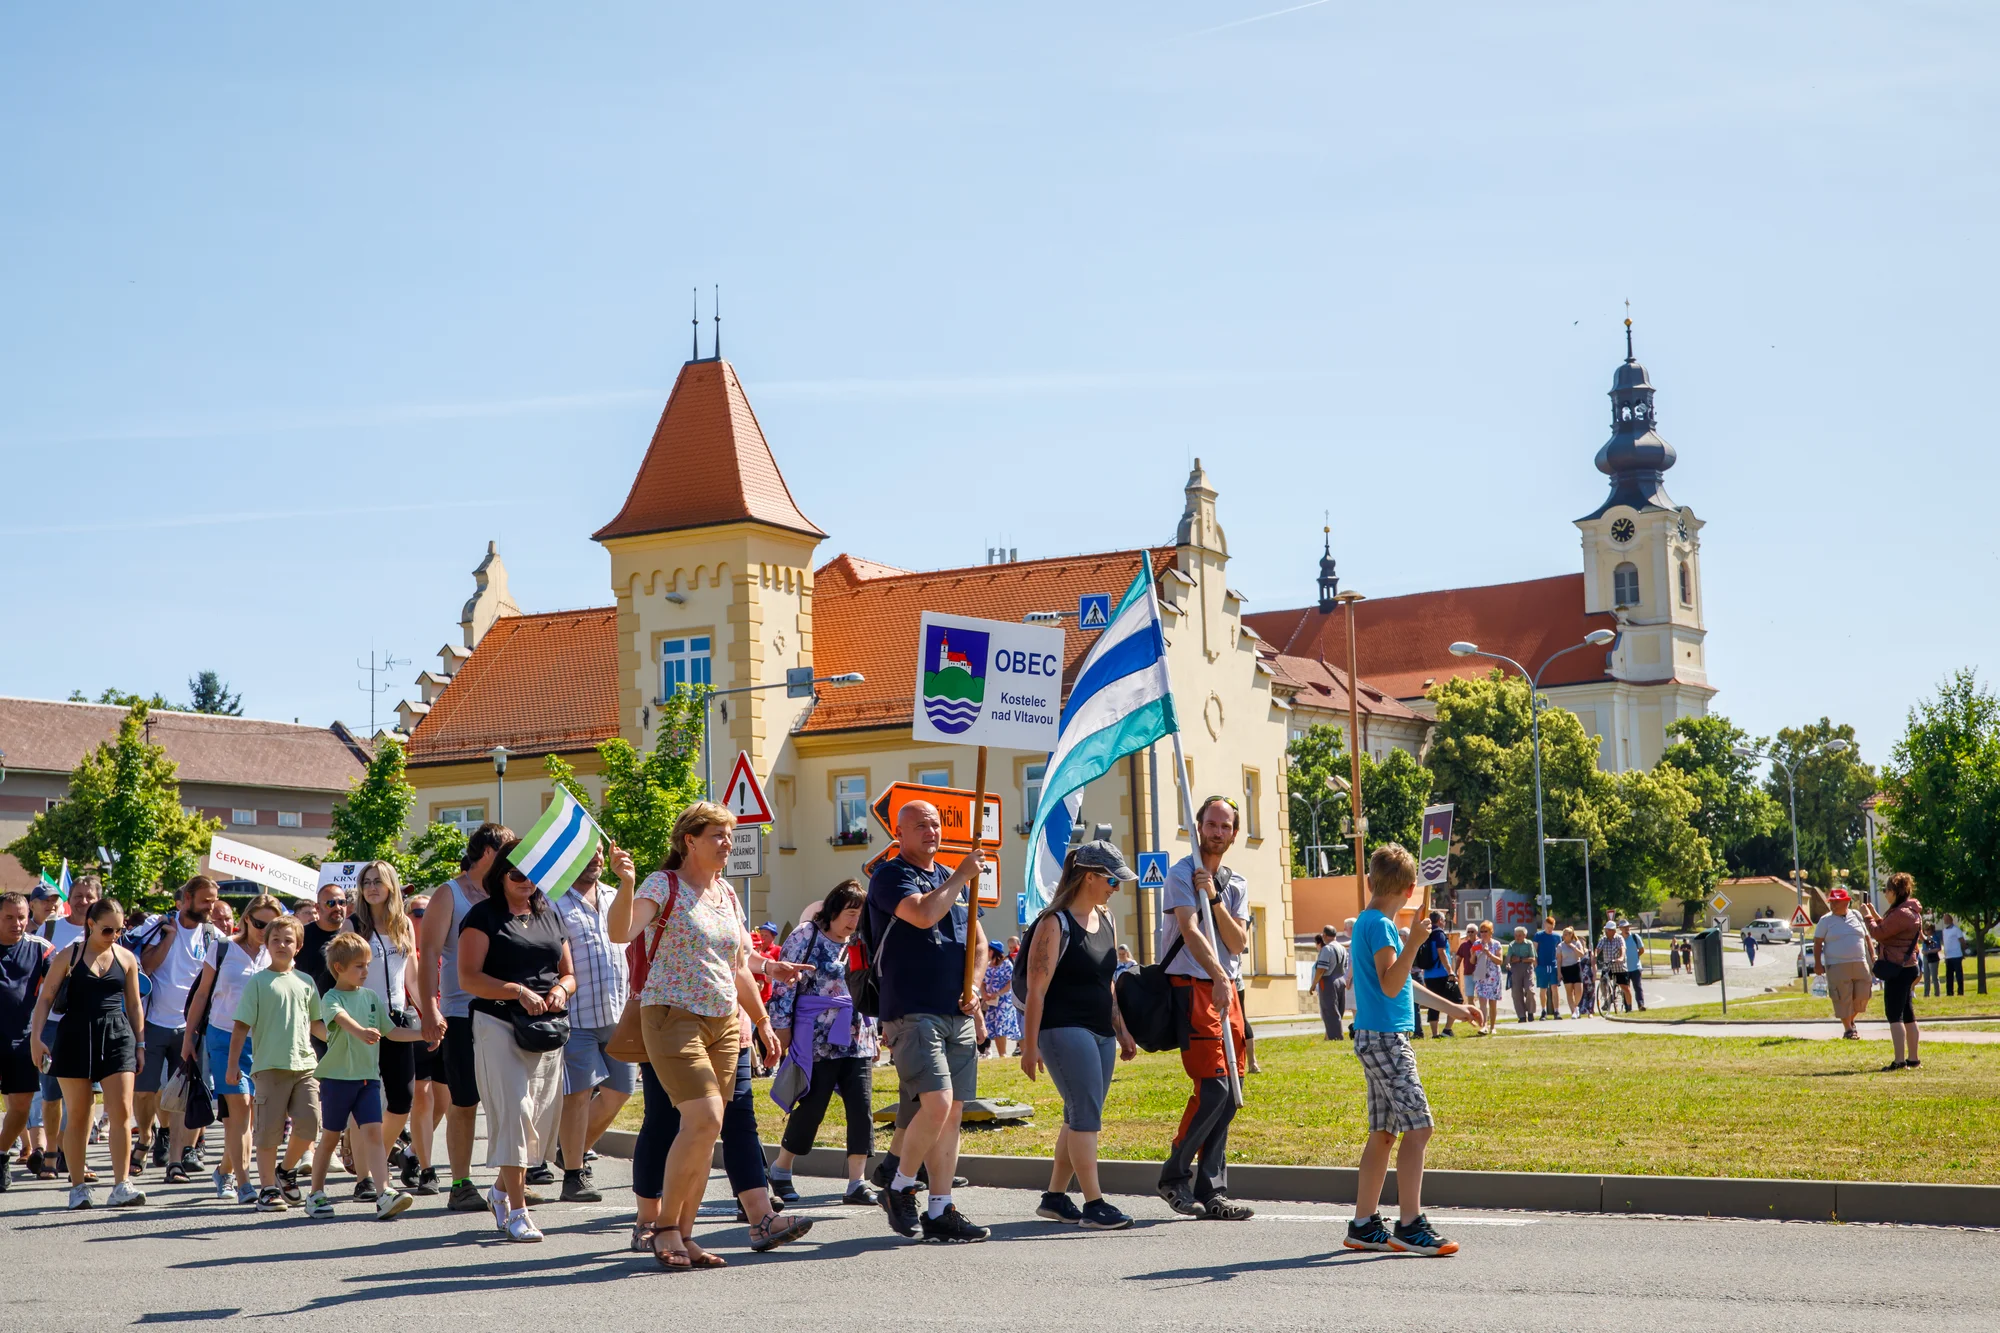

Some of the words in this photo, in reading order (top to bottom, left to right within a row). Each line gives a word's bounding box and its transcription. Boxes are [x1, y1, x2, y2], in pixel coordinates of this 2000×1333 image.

[995, 649, 1057, 677] OBEC
[1000, 692, 1047, 707] Kostelec
[991, 710, 1011, 721] nad
[1014, 710, 1054, 725] Vltavou
[936, 803, 963, 828] NČÍN
[734, 833, 752, 843] VÝJEZD
[215, 850, 265, 873] ČERVENÝ
[268, 867, 316, 892] KOSTELEC
[733, 861, 752, 870] VOZIDEL
[1507, 901, 1534, 924] PSS
